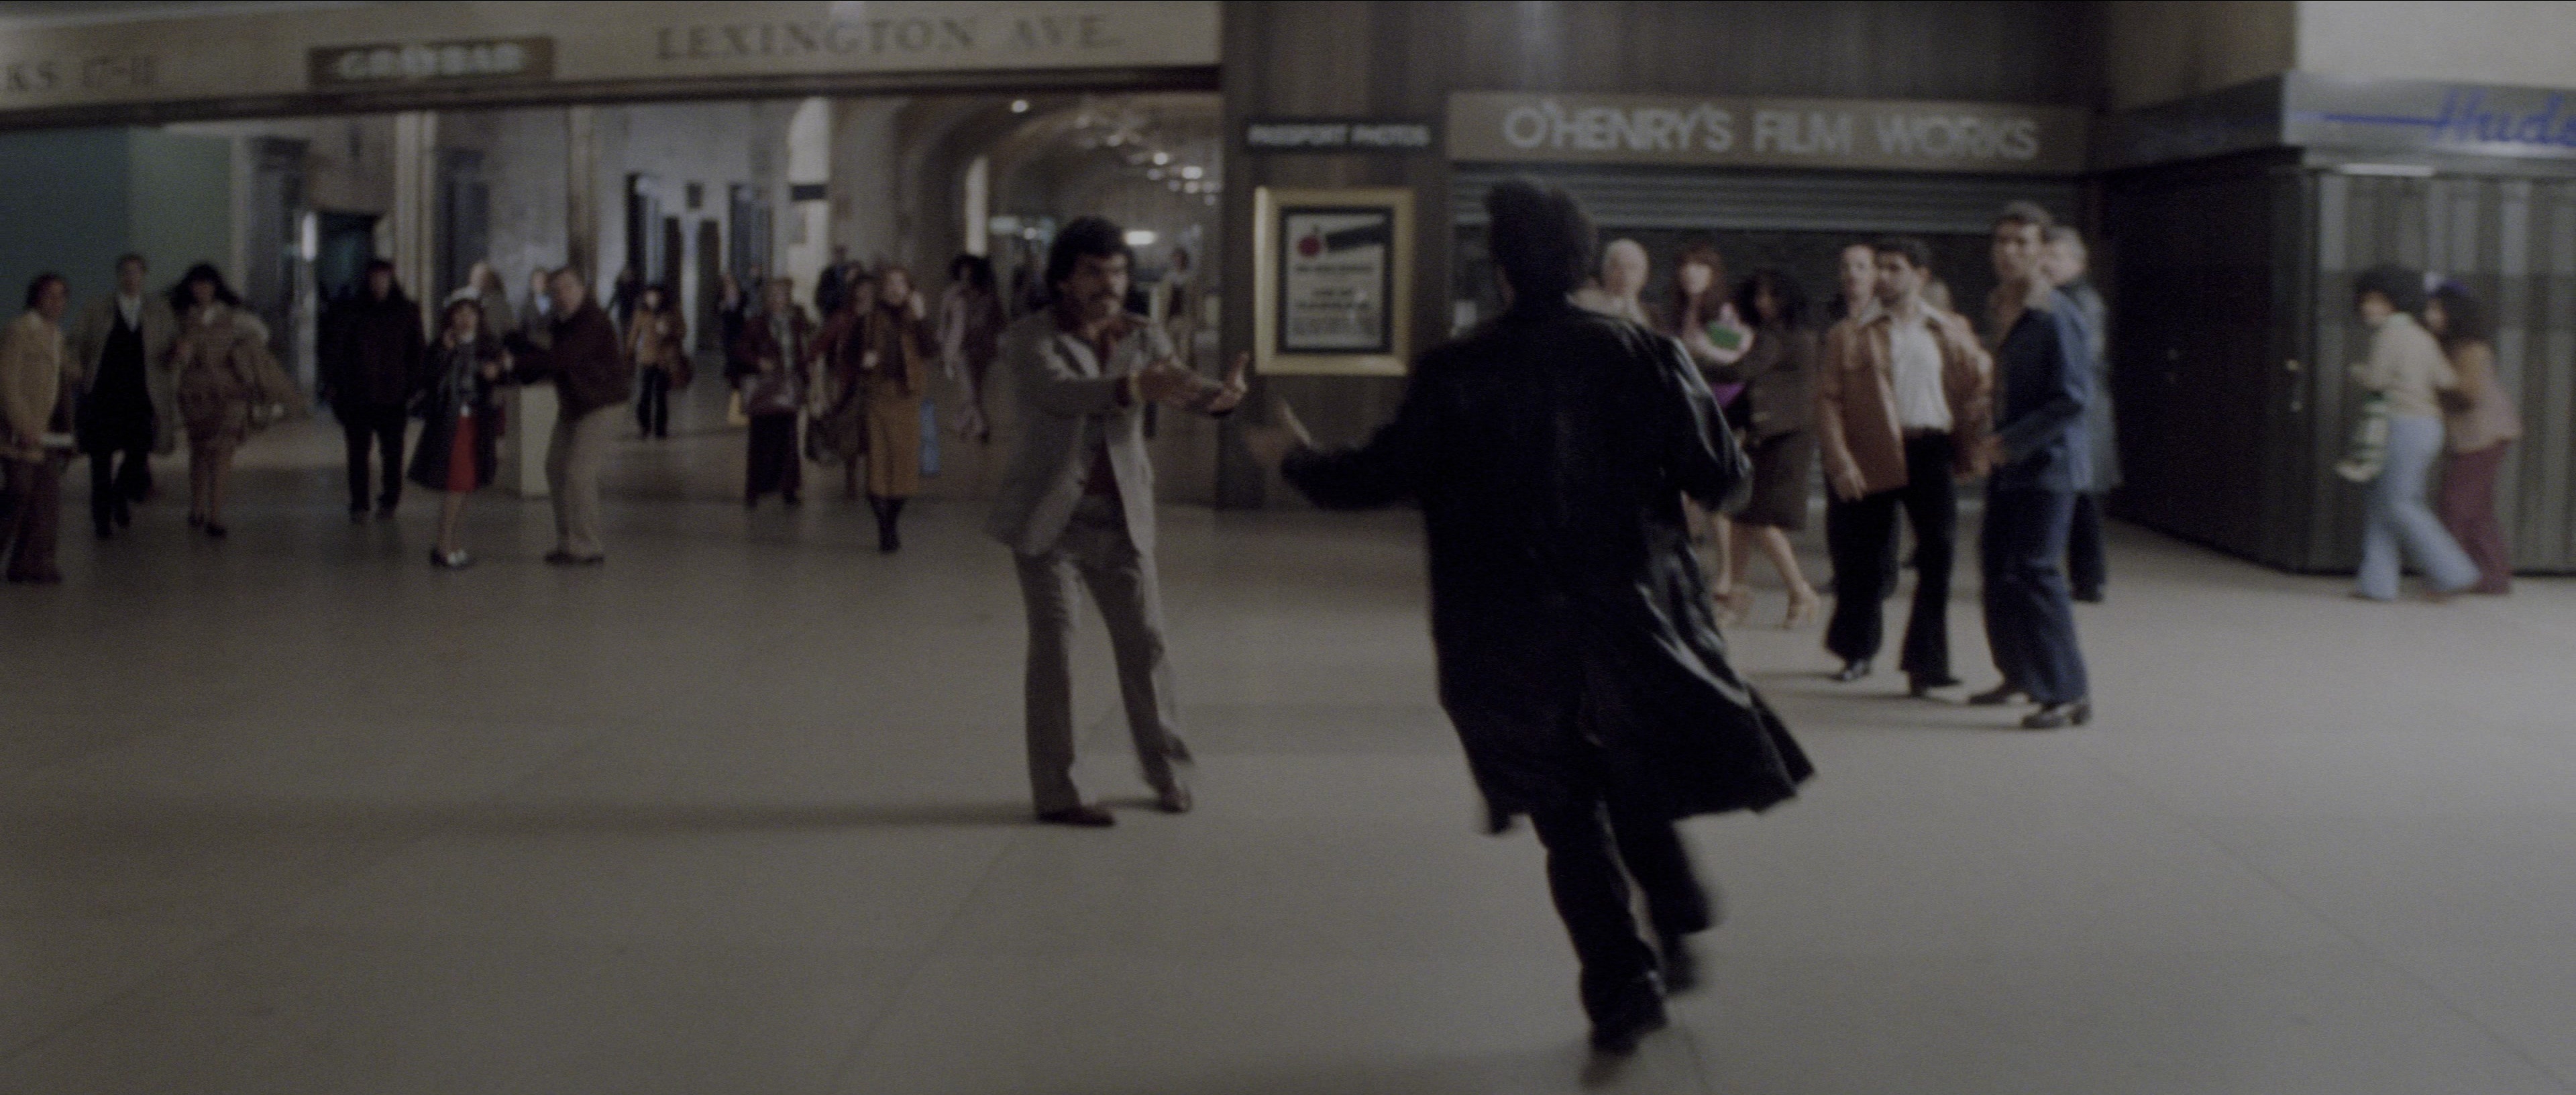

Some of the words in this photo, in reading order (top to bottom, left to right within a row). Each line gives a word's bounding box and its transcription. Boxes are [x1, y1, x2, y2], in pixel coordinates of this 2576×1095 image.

[653, 15, 979, 61] LEXINGTON
[1502, 99, 1735, 153] O'HENRY'S
[1753, 109, 1854, 155] FILM
[1876, 113, 2040, 160] WORKS
